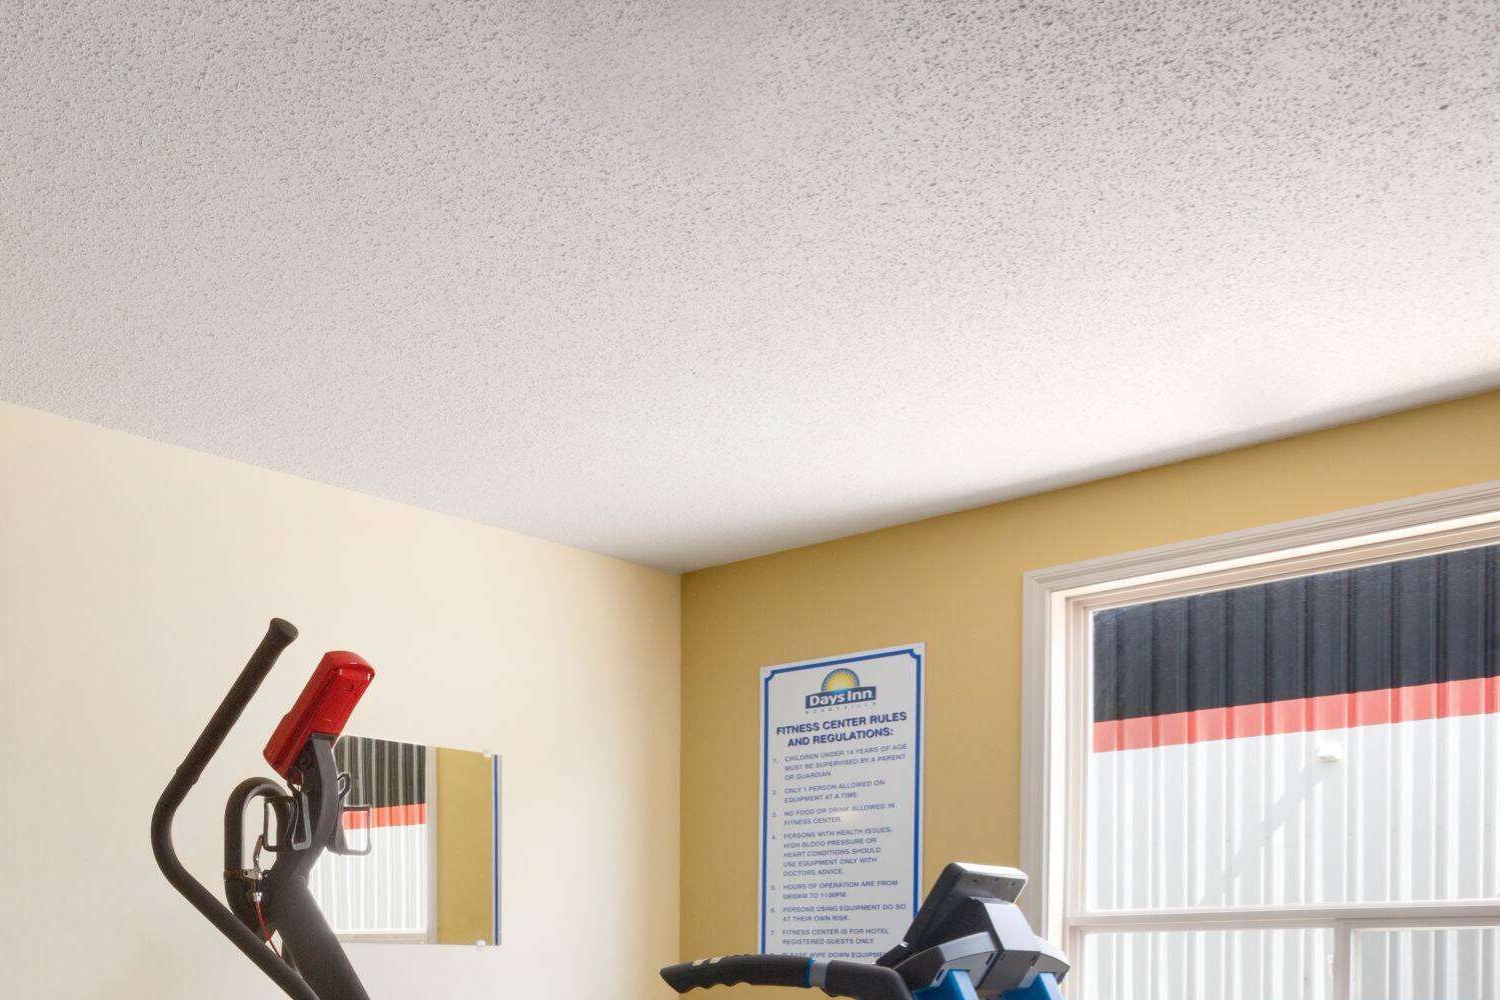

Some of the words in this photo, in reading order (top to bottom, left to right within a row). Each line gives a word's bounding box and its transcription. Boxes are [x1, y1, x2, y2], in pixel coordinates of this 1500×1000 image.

[809, 693, 845, 706] Days
[847, 690, 873, 702] Inn
[776, 722, 820, 736] FITNESS
[822, 716, 867, 730] CENTER
[869, 711, 907, 724] RULES
[787, 736, 810, 747] AND
[812, 727, 894, 743] REGULATIONS:
[784, 752, 819, 762] CHILDREN
[820, 750, 844, 759] UNDER
[855, 747, 879, 755] YEARS
[891, 743, 907, 751] AGE
[815, 759, 858, 769] SUPERVISED
[877, 753, 907, 762] PARENT
[796, 771, 832, 780] GUARDIAN
[808, 783, 837, 792] PERSON
[838, 780, 872, 789] ALLOWED
[784, 795, 823, 804] EQUIPMENT
[828, 806, 850, 814] DRINK
[851, 803, 886, 811] ALLOWED
[783, 818, 812, 826] FITNESS
[783, 832, 816, 840] PERSONS
[801, 840, 826, 848] BLOOD
[826, 838, 864, 846] PRESSURE
[806, 848, 850, 857] CONDITIONS
[797, 859, 838, 868] EQUIPMENT
[783, 869, 816, 877] DOCTORS
[819, 881, 860, 889] OPERATION
[839, 904, 881, 912] EQUIPMENT
